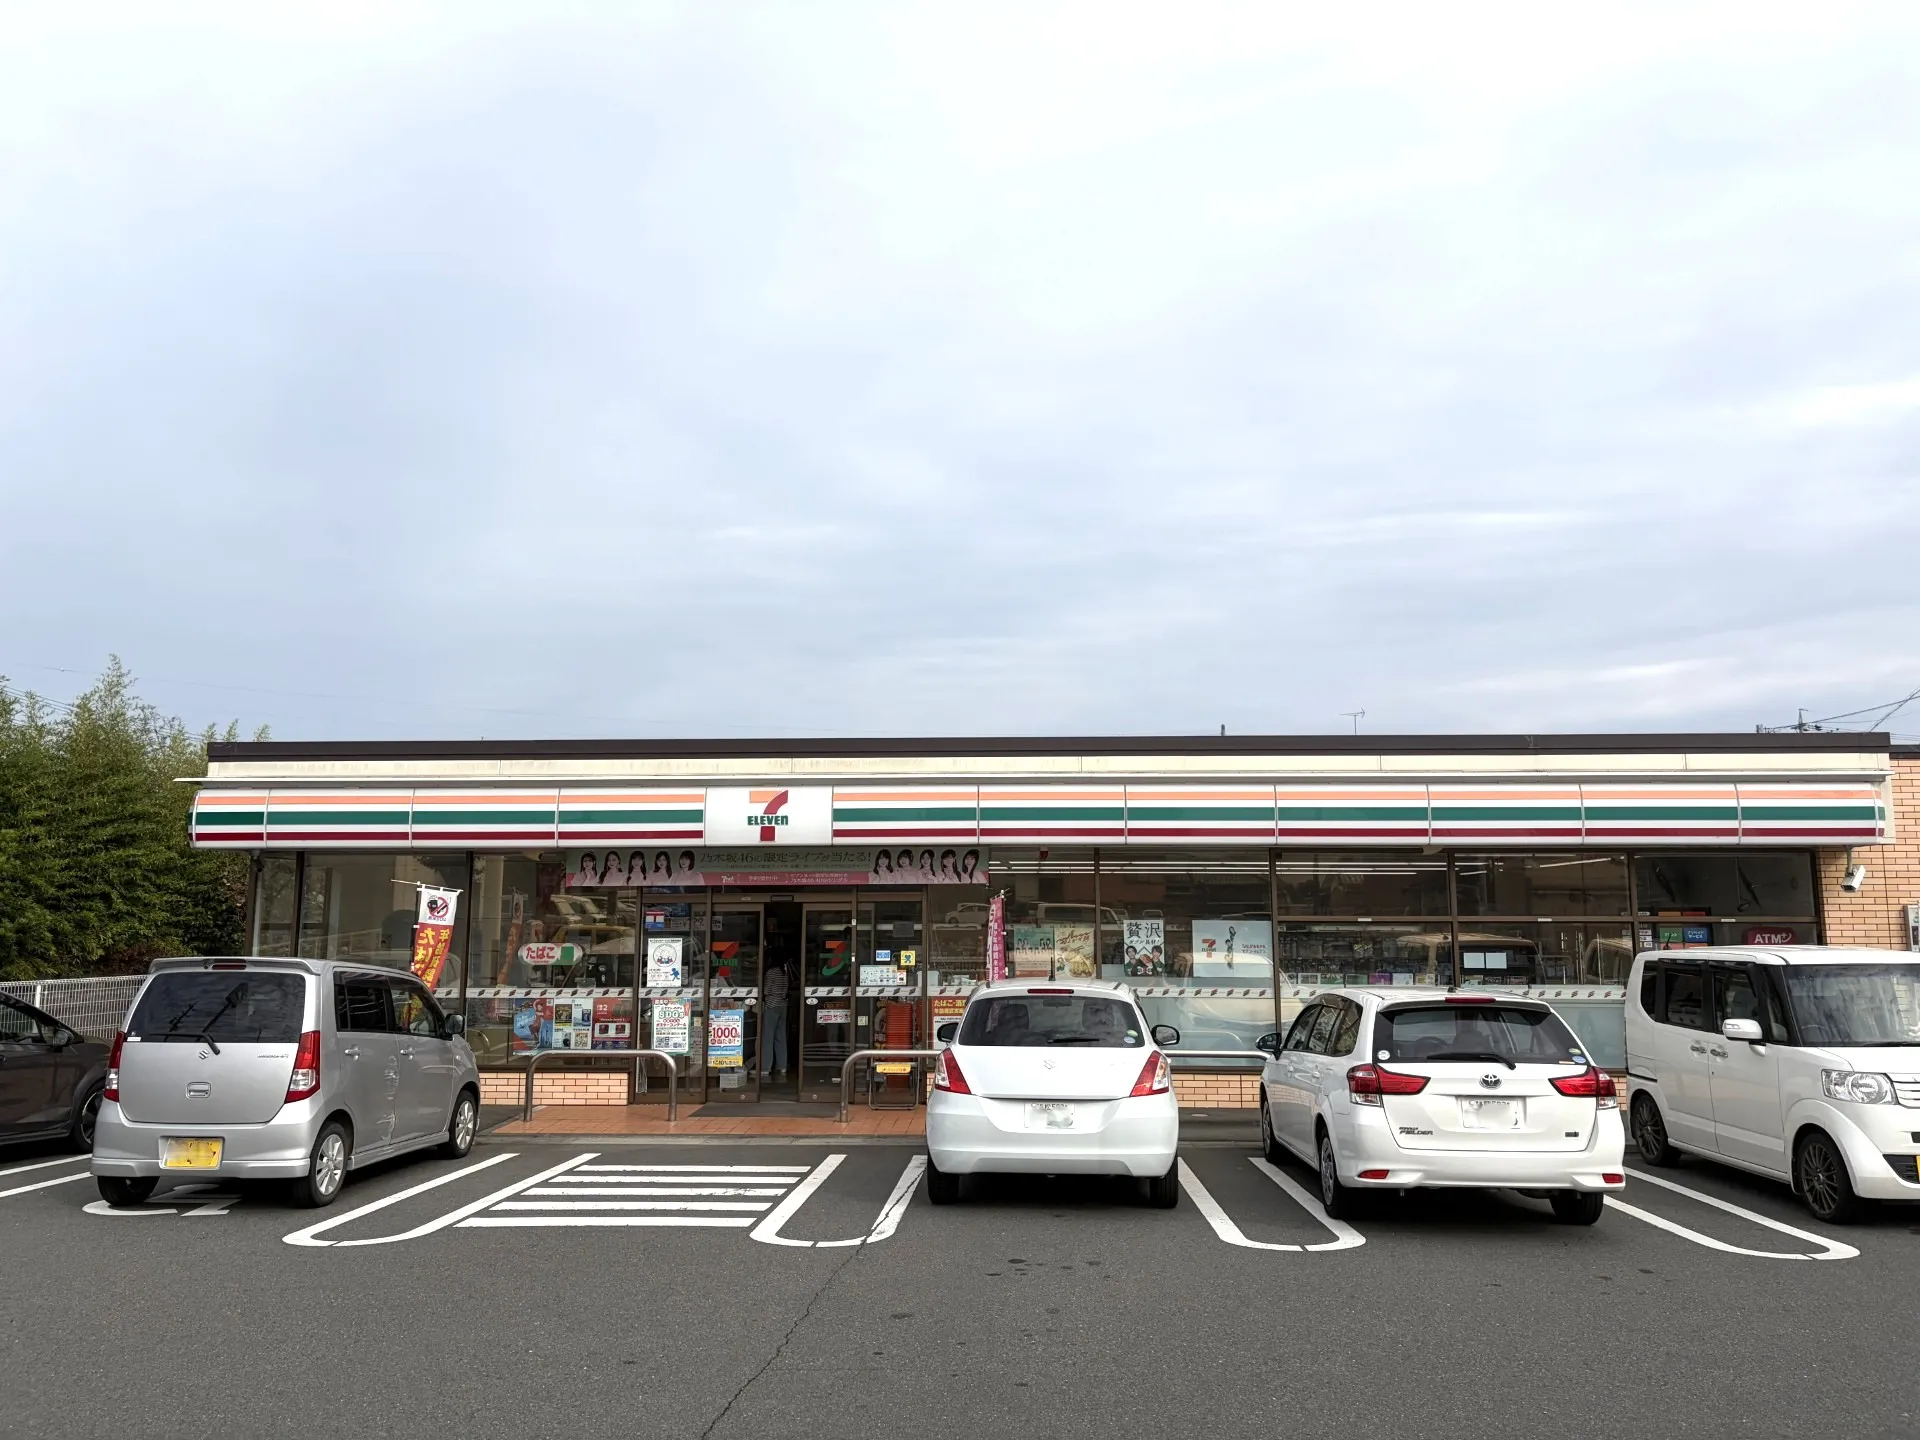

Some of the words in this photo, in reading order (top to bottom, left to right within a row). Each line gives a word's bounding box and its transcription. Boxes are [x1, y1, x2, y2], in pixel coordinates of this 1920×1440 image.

[1126, 922, 1163, 938] 贅沢
[1754, 933, 1782, 944] ATM
[526, 945, 556, 960] たばこ
